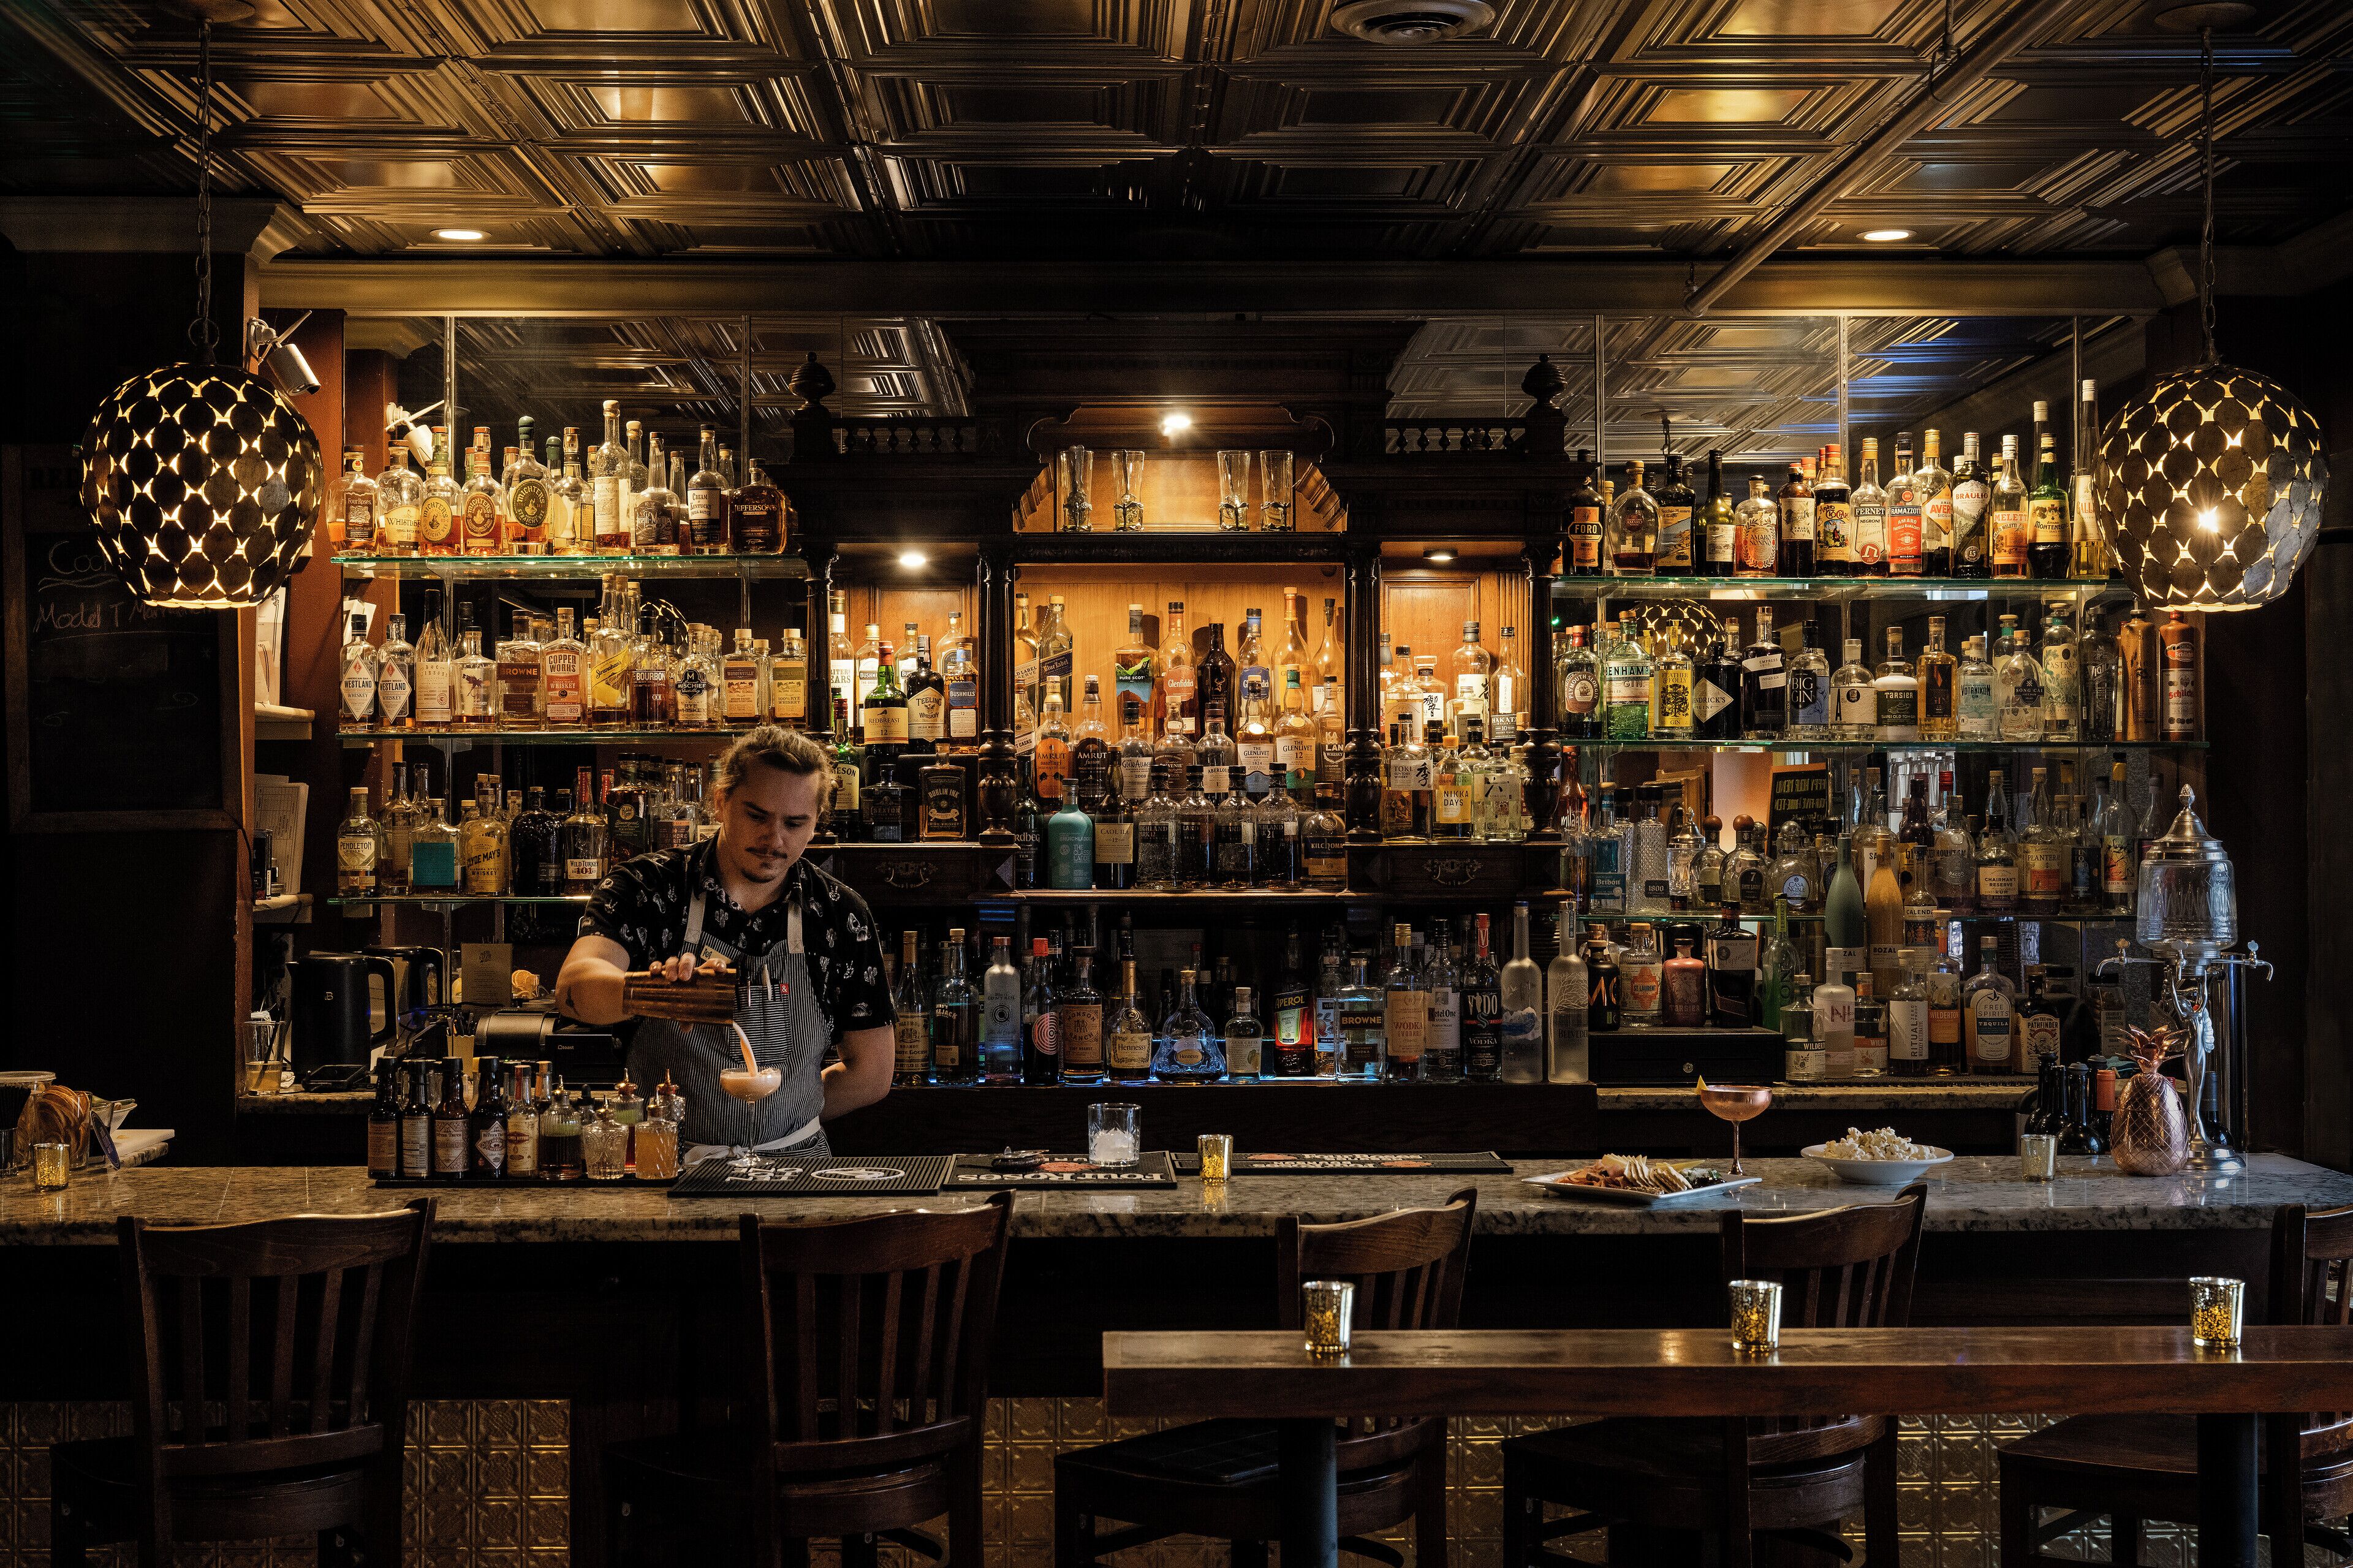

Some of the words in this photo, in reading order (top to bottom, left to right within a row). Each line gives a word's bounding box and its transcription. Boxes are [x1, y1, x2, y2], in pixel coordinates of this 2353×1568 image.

[517, 487, 545, 504] MICHTER'S
[423, 502, 448, 518] MICHTER'S
[468, 498, 492, 513] MICHTER'S
[517, 509, 539, 523] STRAIGHT
[1575, 525, 1597, 534] FORO
[2034, 521, 2069, 529] MONTENEGRO
[548, 654, 576, 665] COPPER
[1055, 659, 1069, 668] Label
[550, 663, 576, 673] WORKS
[596, 660, 622, 679] Stranahan's
[1021, 666, 1037, 675] LABEL
[380, 682, 406, 691] WESTLAND
[1168, 679, 1194, 687] Glenfiddich
[1569, 673, 1588, 699] PLYMOUTH
[1792, 677, 1813, 690] BIG
[1961, 685, 1991, 695] VOTANIKON
[1791, 690, 1813, 703] GIN
[916, 698, 942, 706] TEELING
[1019, 739, 1033, 748] CASKS
[928, 789, 948, 798] DUBLIN
[949, 789, 960, 798] INK
[340, 841, 372, 850] PENDLETON
[467, 857, 482, 868] CLYDE
[483, 850, 501, 863] MAY'S
[1750, 872, 1756, 882] 7
[1480, 930, 1487, 946] V
[1276, 996, 1305, 1009] APEROL
[1067, 1012, 1096, 1022] MONSON
[1118, 1043, 1146, 1052] Hennessy
[957, 1172, 1076, 1181] Roses
[1077, 1173, 1165, 1181] Four
